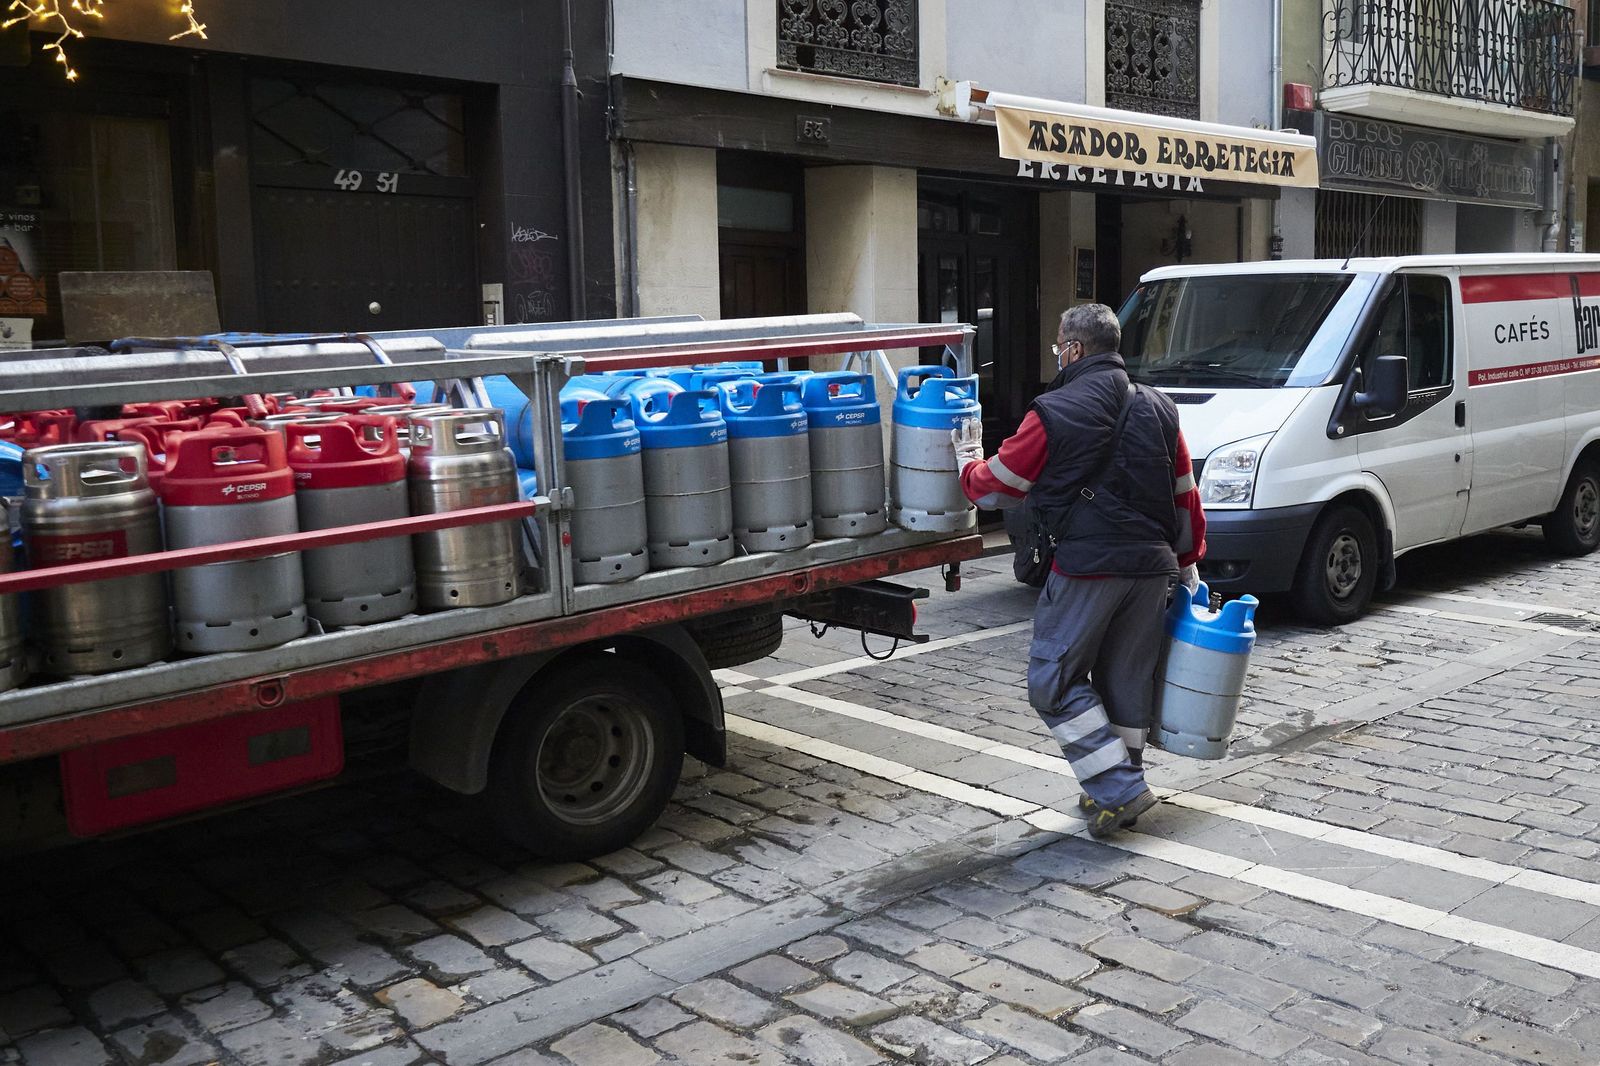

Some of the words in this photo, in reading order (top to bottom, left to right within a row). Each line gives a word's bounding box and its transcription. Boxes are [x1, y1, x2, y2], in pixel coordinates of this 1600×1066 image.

[1028, 119, 1147, 165] ASADOR
[1329, 118, 1403, 146] BOLSOS
[1327, 140, 1403, 181] GLOBE
[333, 169, 362, 191] 49
[376, 172, 399, 194] 51
[14, 222, 33, 233] bar
[1494, 314, 1550, 344] CAFÉS
[1478, 373, 1487, 382] Pol.
[1487, 370, 1508, 380] Industrial
[1509, 369, 1519, 378] calle
[845, 412, 865, 420] CEPSA
[236, 482, 267, 493] CEPSA
